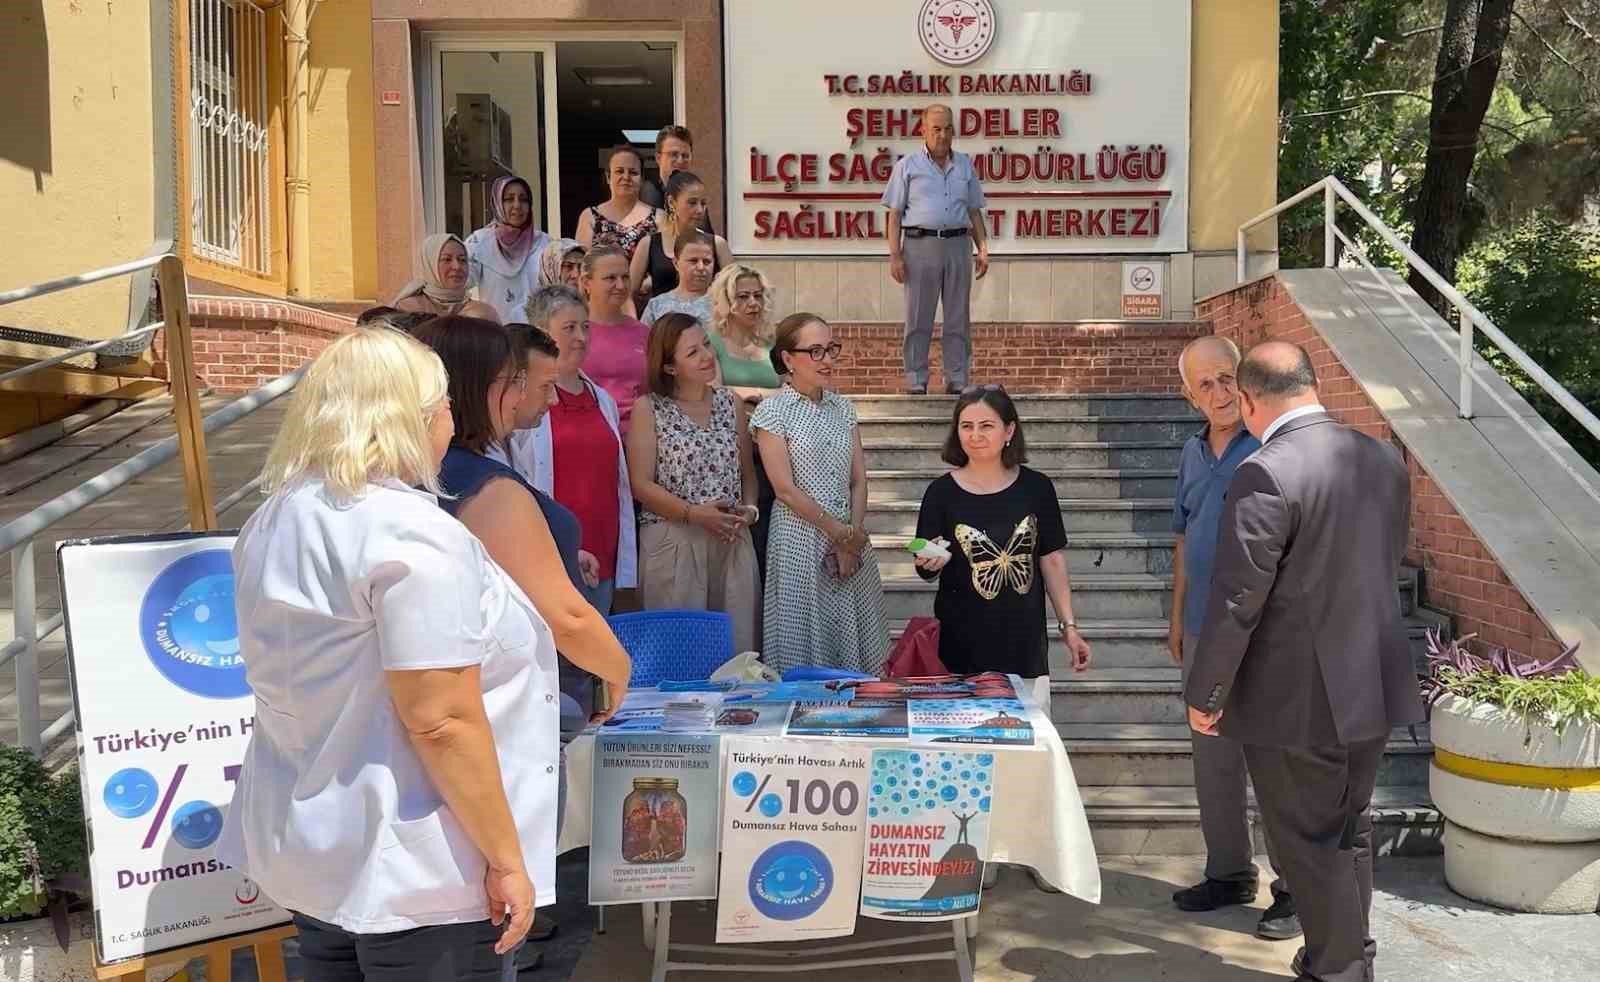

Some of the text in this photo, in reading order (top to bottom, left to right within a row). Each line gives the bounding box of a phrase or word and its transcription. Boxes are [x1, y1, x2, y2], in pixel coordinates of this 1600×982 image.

[867, 70, 951, 94] SAĞLIK
[959, 70, 1093, 94] BAKANLIĞI
[846, 108, 1061, 148] ŞEHZDELER
[750, 147, 818, 192] İLÇE
[828, 147, 904, 182] SAĞ
[1016, 201, 1161, 238] MERKEZİ
[156, 628, 213, 666] DUMANSIZ
[93, 720, 232, 754] Türkiye'nin
[732, 752, 865, 769] Türkiye'nin Havası Artık
[732, 820, 857, 832] Dumansız Hava Sahası
[870, 824, 946, 840] DUMANSIZ
[869, 842, 931, 858] HAYATIN
[117, 857, 233, 889] Dumansı
